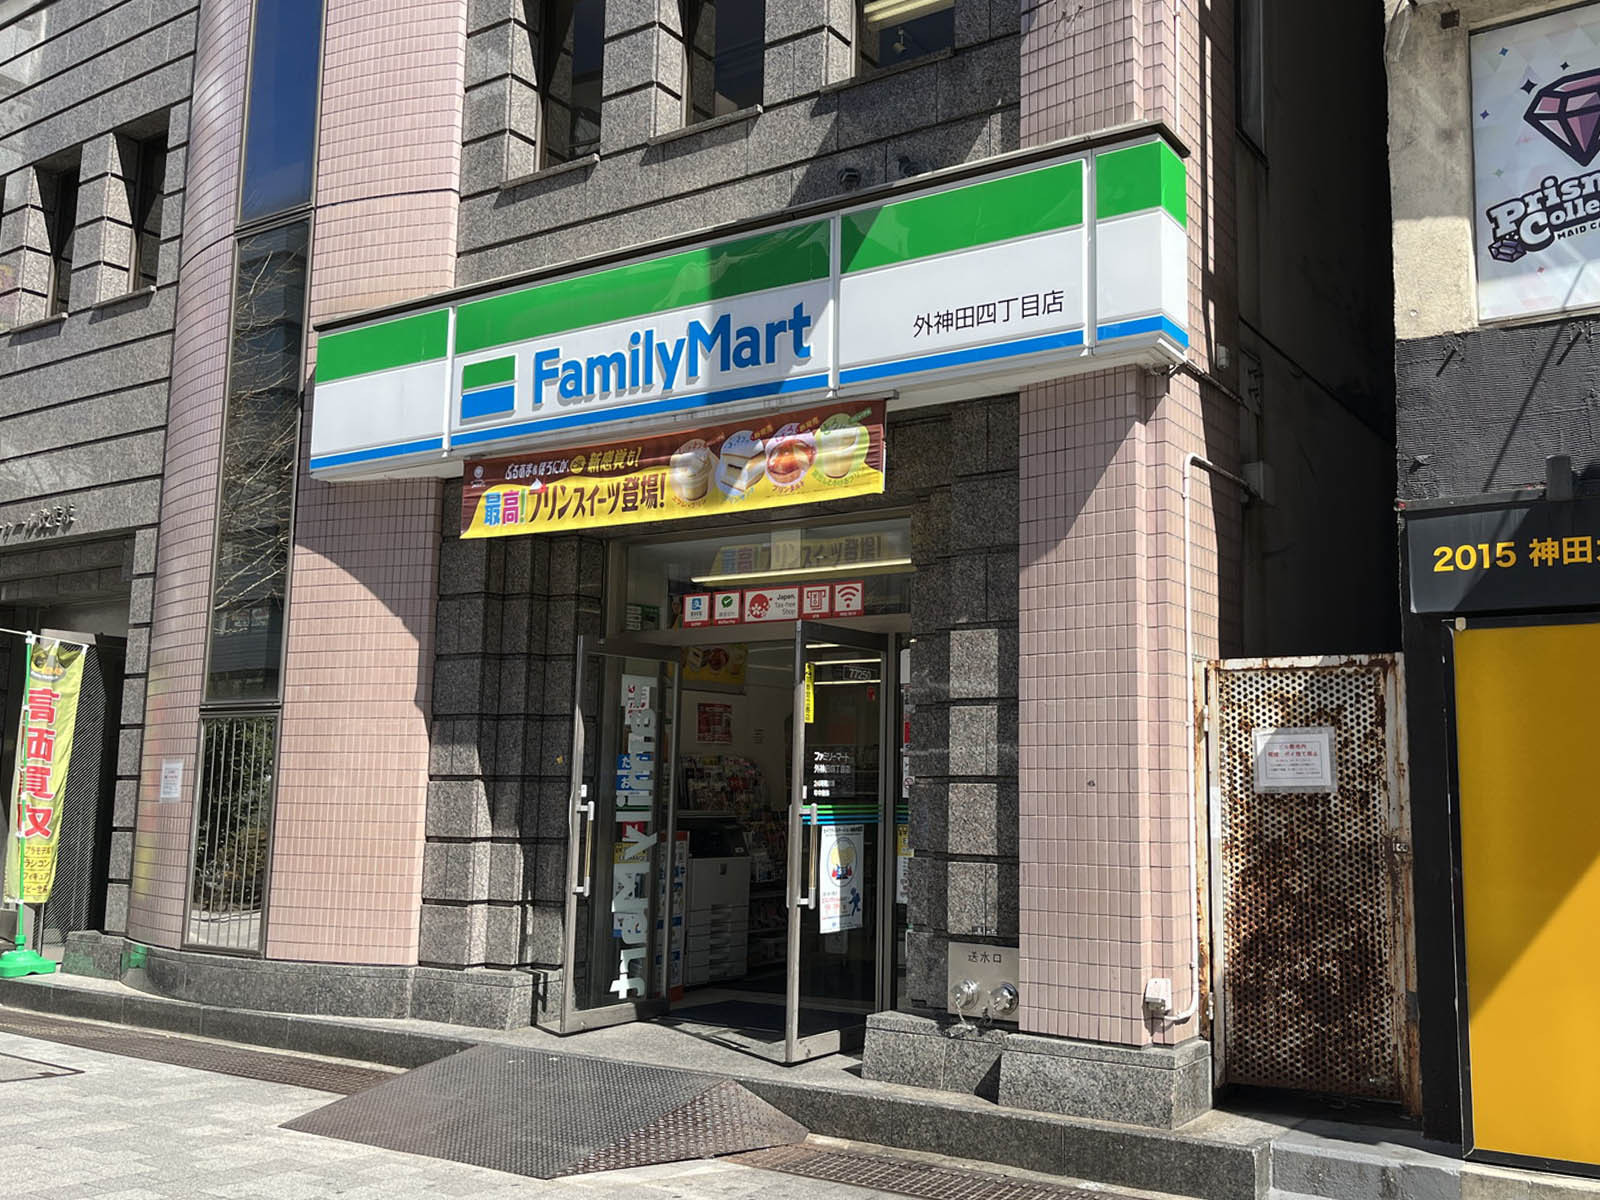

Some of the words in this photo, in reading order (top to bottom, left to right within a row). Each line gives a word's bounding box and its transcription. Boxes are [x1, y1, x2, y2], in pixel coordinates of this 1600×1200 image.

[1557, 225, 1587, 240] MAID
[913, 290, 1064, 338] 外神田四丁目店
[534, 302, 811, 405] FamilyMart
[1433, 542, 1517, 572] 2015
[1529, 536, 1600, 568] 神田
[968, 951, 1002, 963] 送水口
